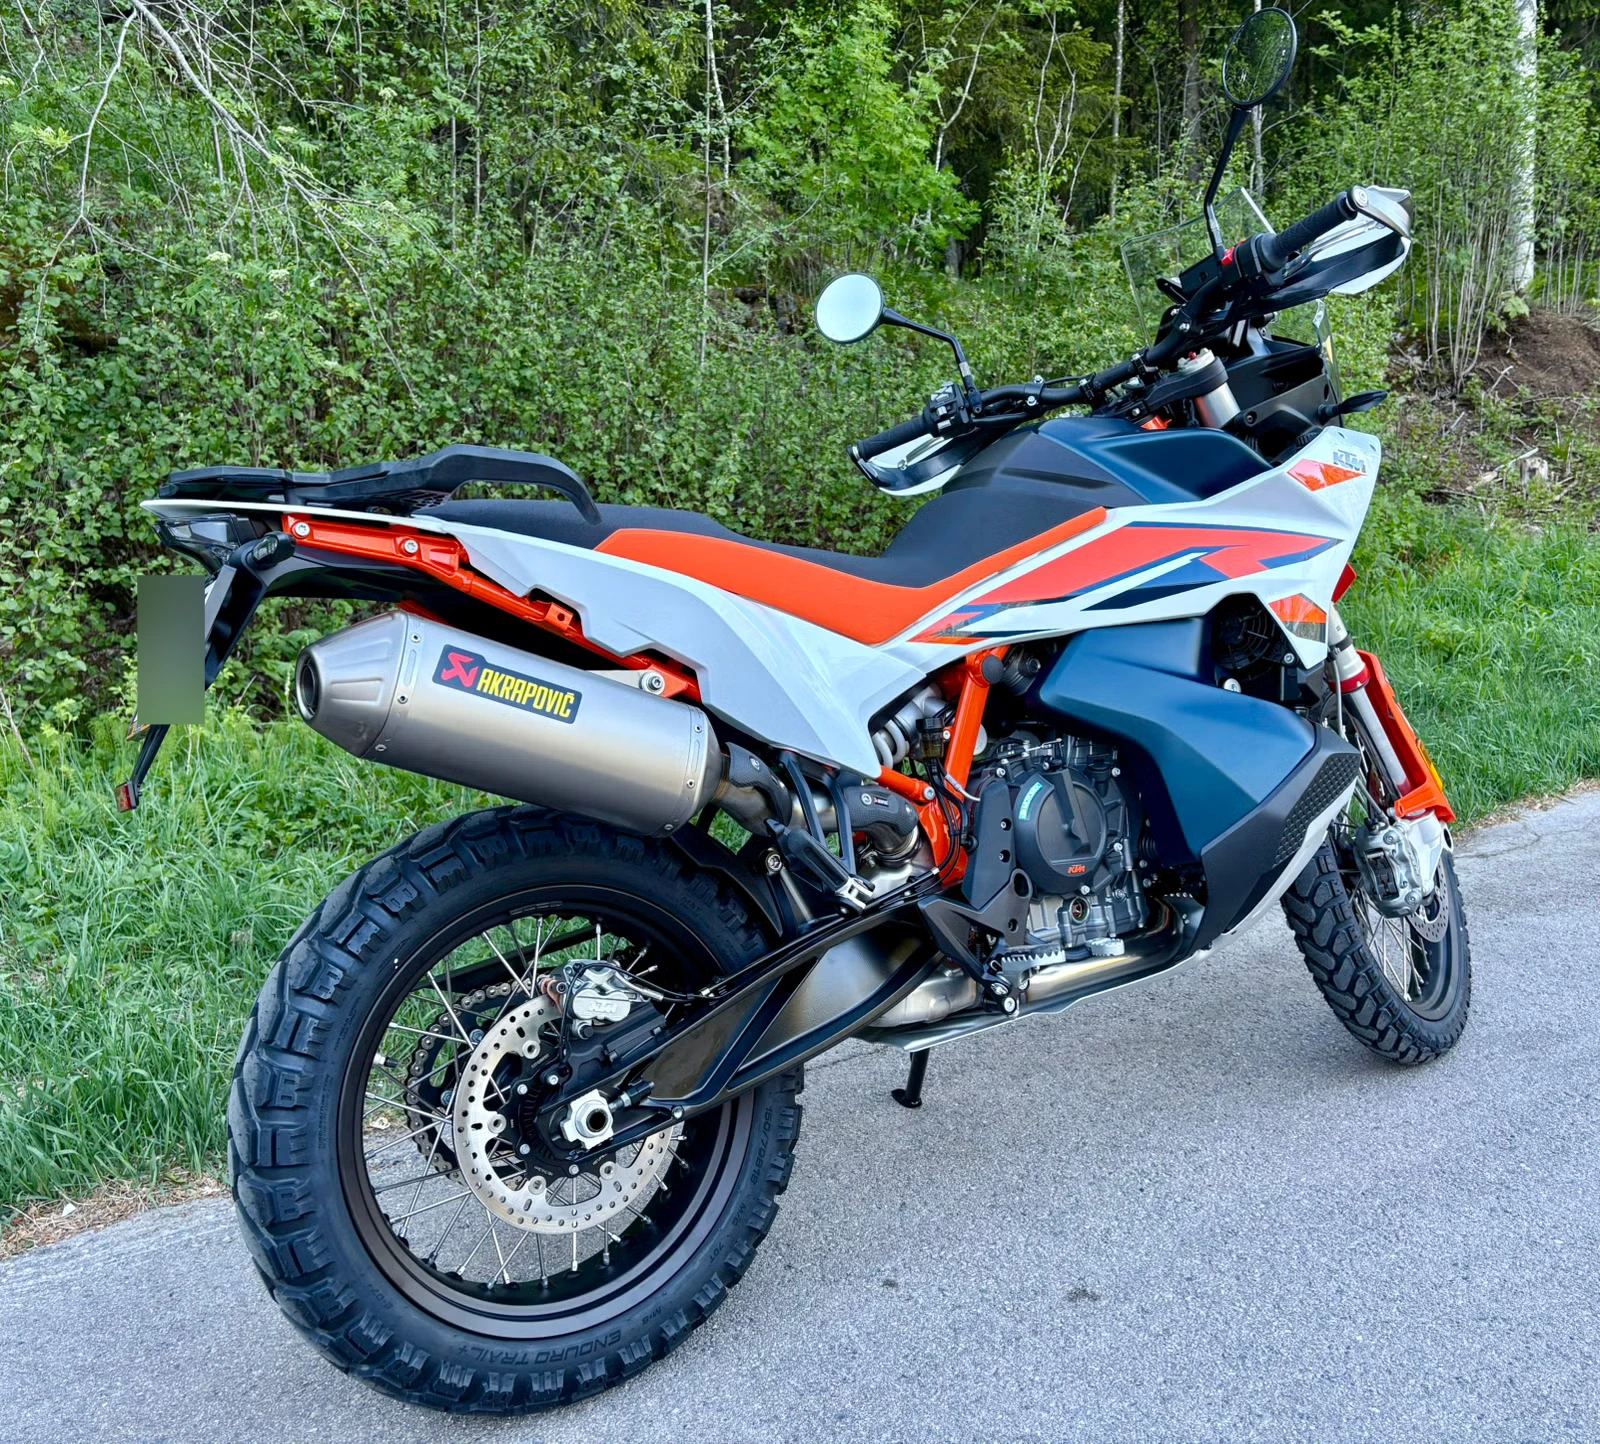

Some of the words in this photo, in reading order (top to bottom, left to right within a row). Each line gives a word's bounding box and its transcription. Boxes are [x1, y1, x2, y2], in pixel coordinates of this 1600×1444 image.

[1333, 450, 1366, 473] KTM
[476, 667, 575, 718] AKRAPOVIČ
[1068, 865, 1086, 874] KTM
[534, 1330, 621, 1365] ENDURO
